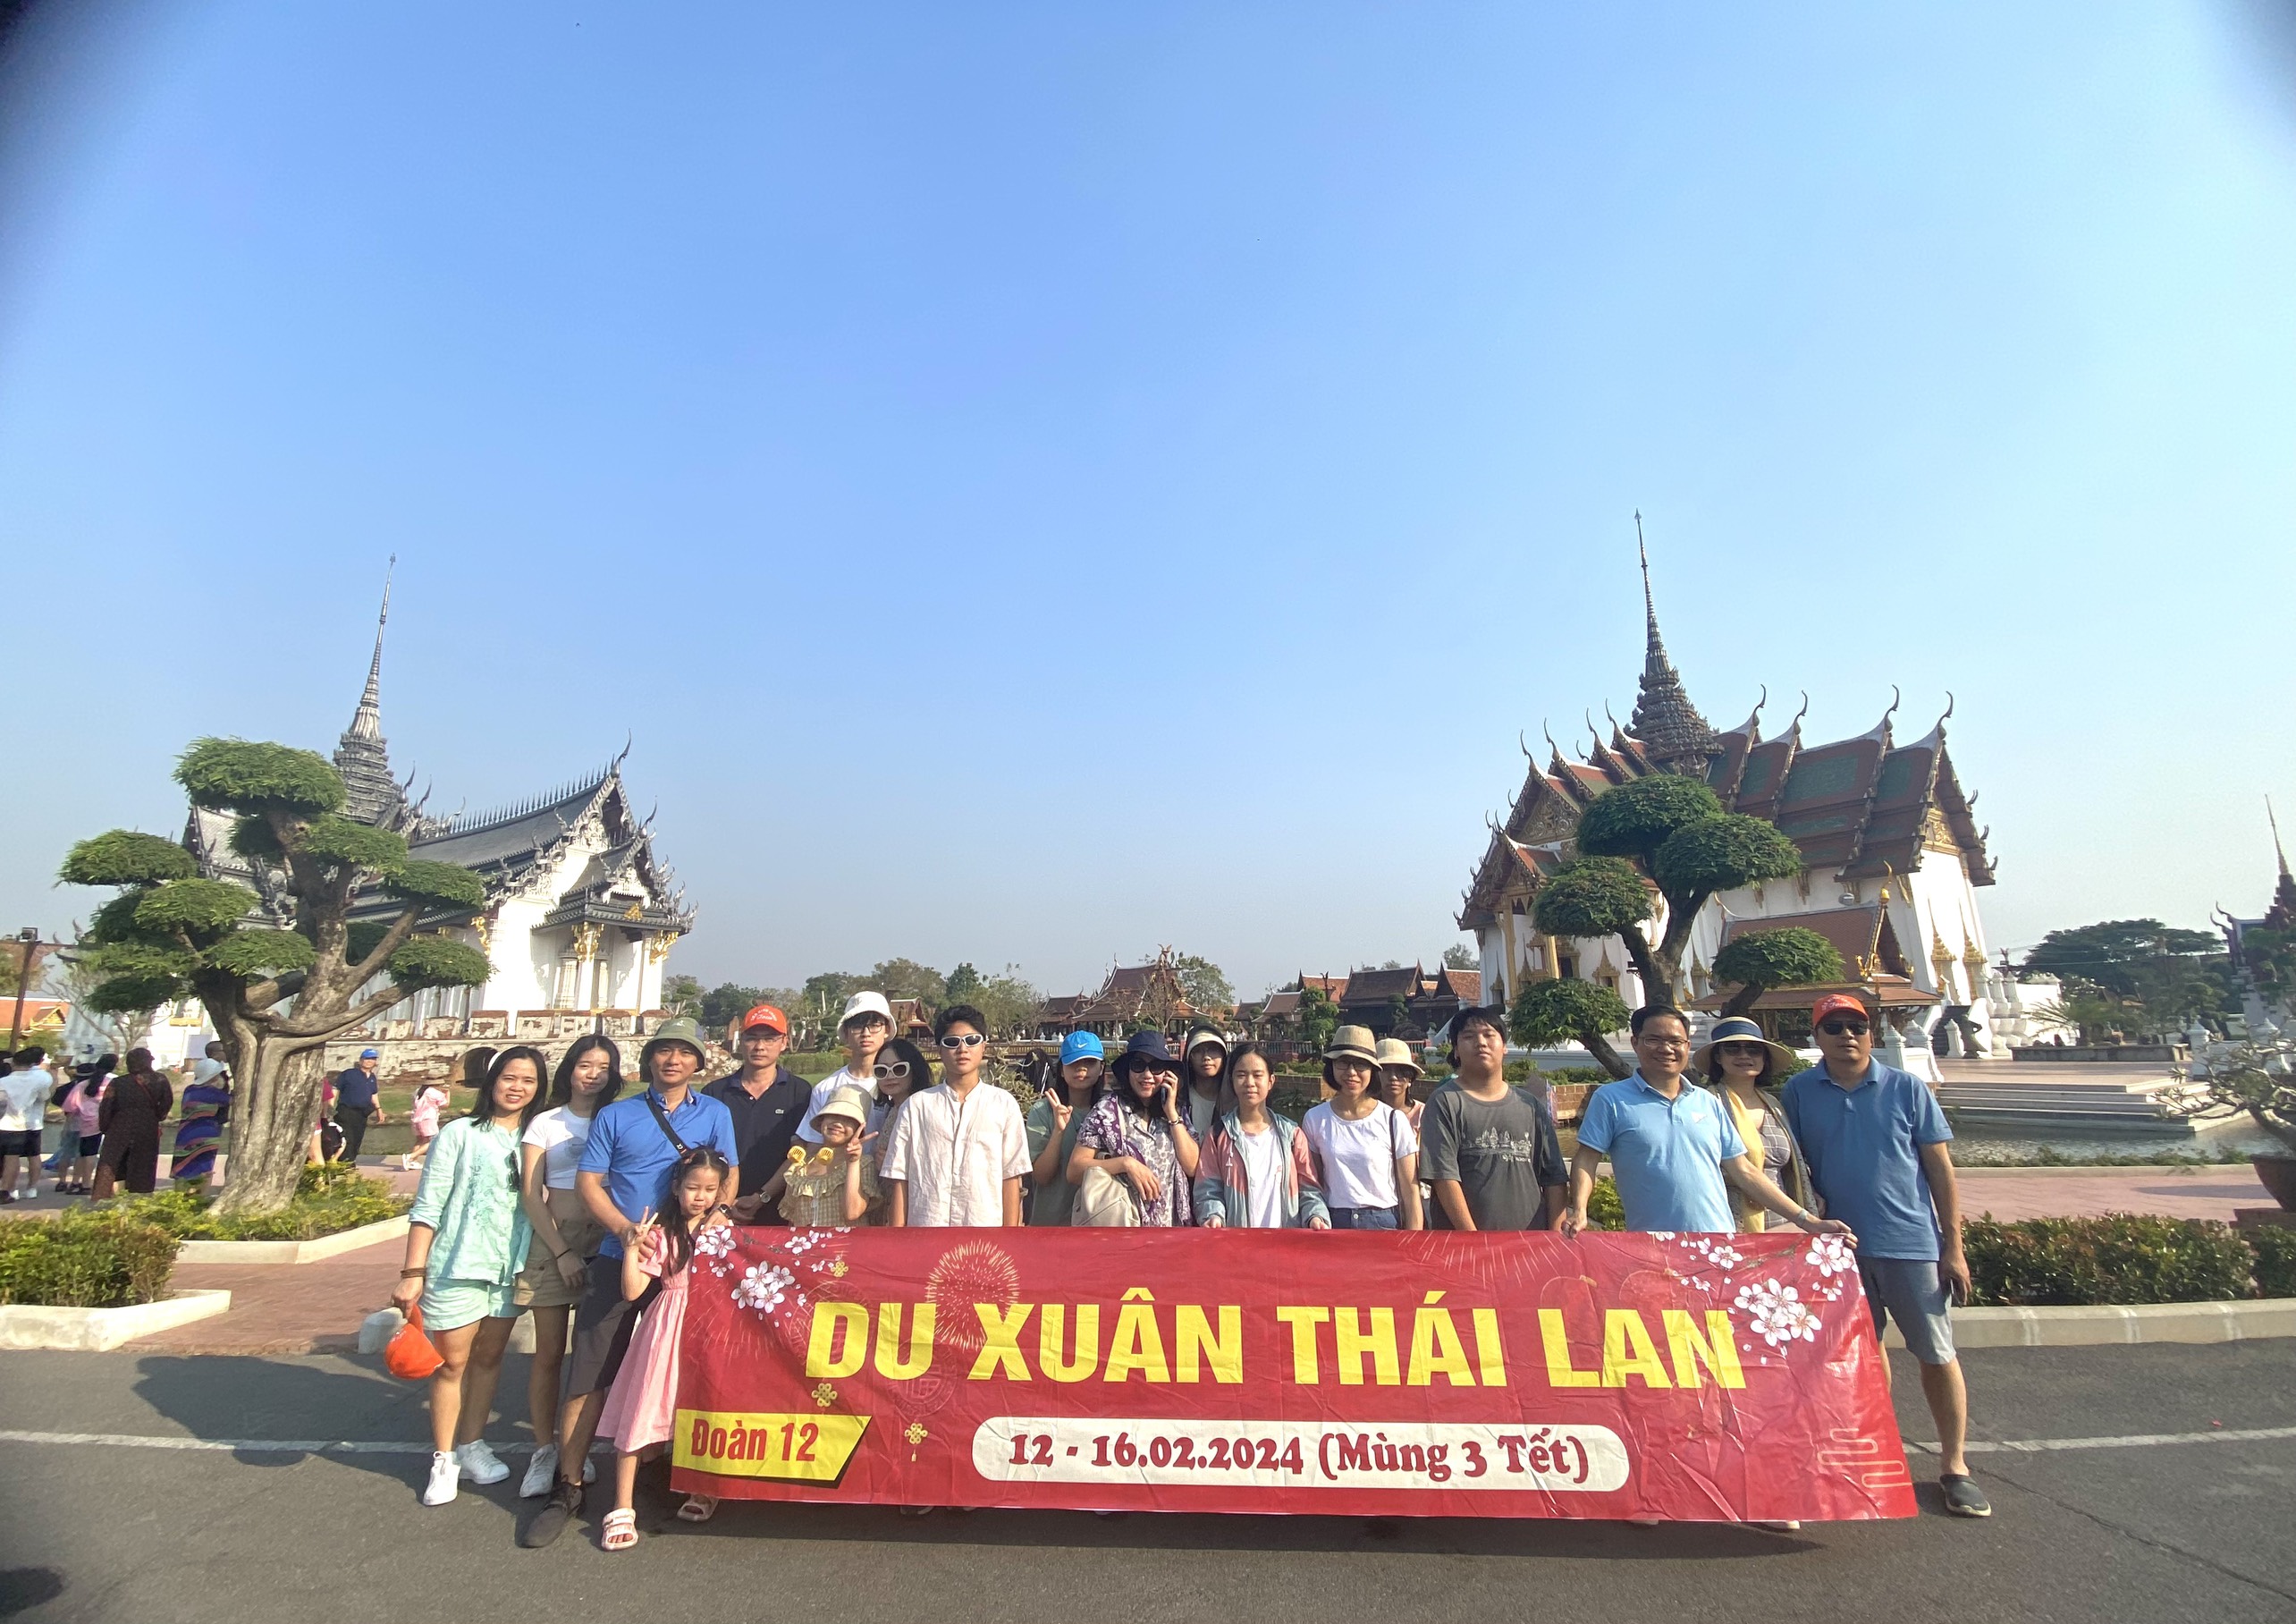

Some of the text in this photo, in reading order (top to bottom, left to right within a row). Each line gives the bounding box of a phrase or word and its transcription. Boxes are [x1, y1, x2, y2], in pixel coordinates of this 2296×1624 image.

[806, 1287, 1747, 1390] DU XUÂN THÁI LAN
[691, 1418, 819, 1462] Đoàn 12
[1009, 1427, 1589, 1484] 12 - 16.02.2024 (Mùng 3 Tết)
